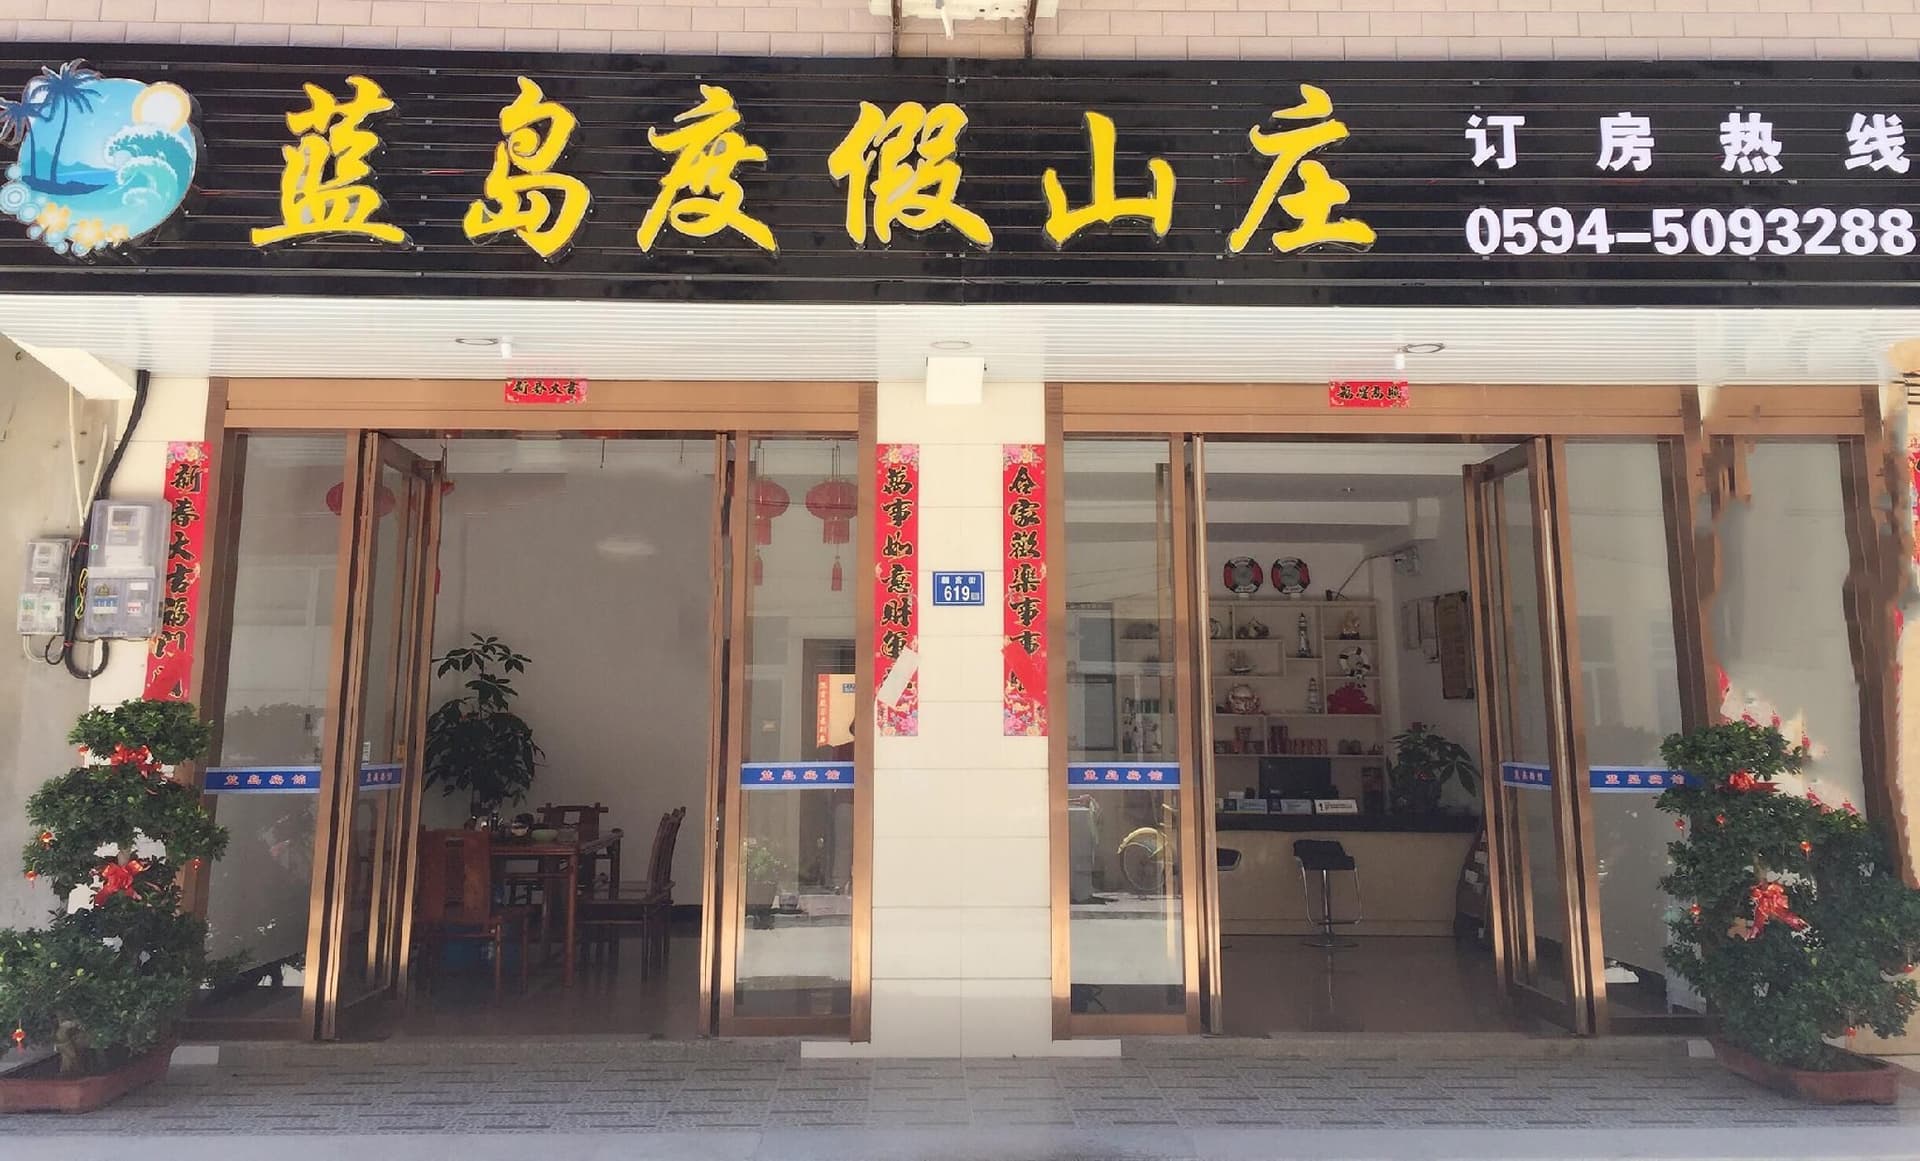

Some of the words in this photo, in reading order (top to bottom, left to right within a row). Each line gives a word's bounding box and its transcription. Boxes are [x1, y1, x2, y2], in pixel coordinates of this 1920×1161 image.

[250, 75, 1377, 260] 蓝岛度假山庄
[1465, 112, 1911, 174] 订房热线
[1465, 207, 1917, 256] 0594-5093288
[944, 585, 970, 601] 619
